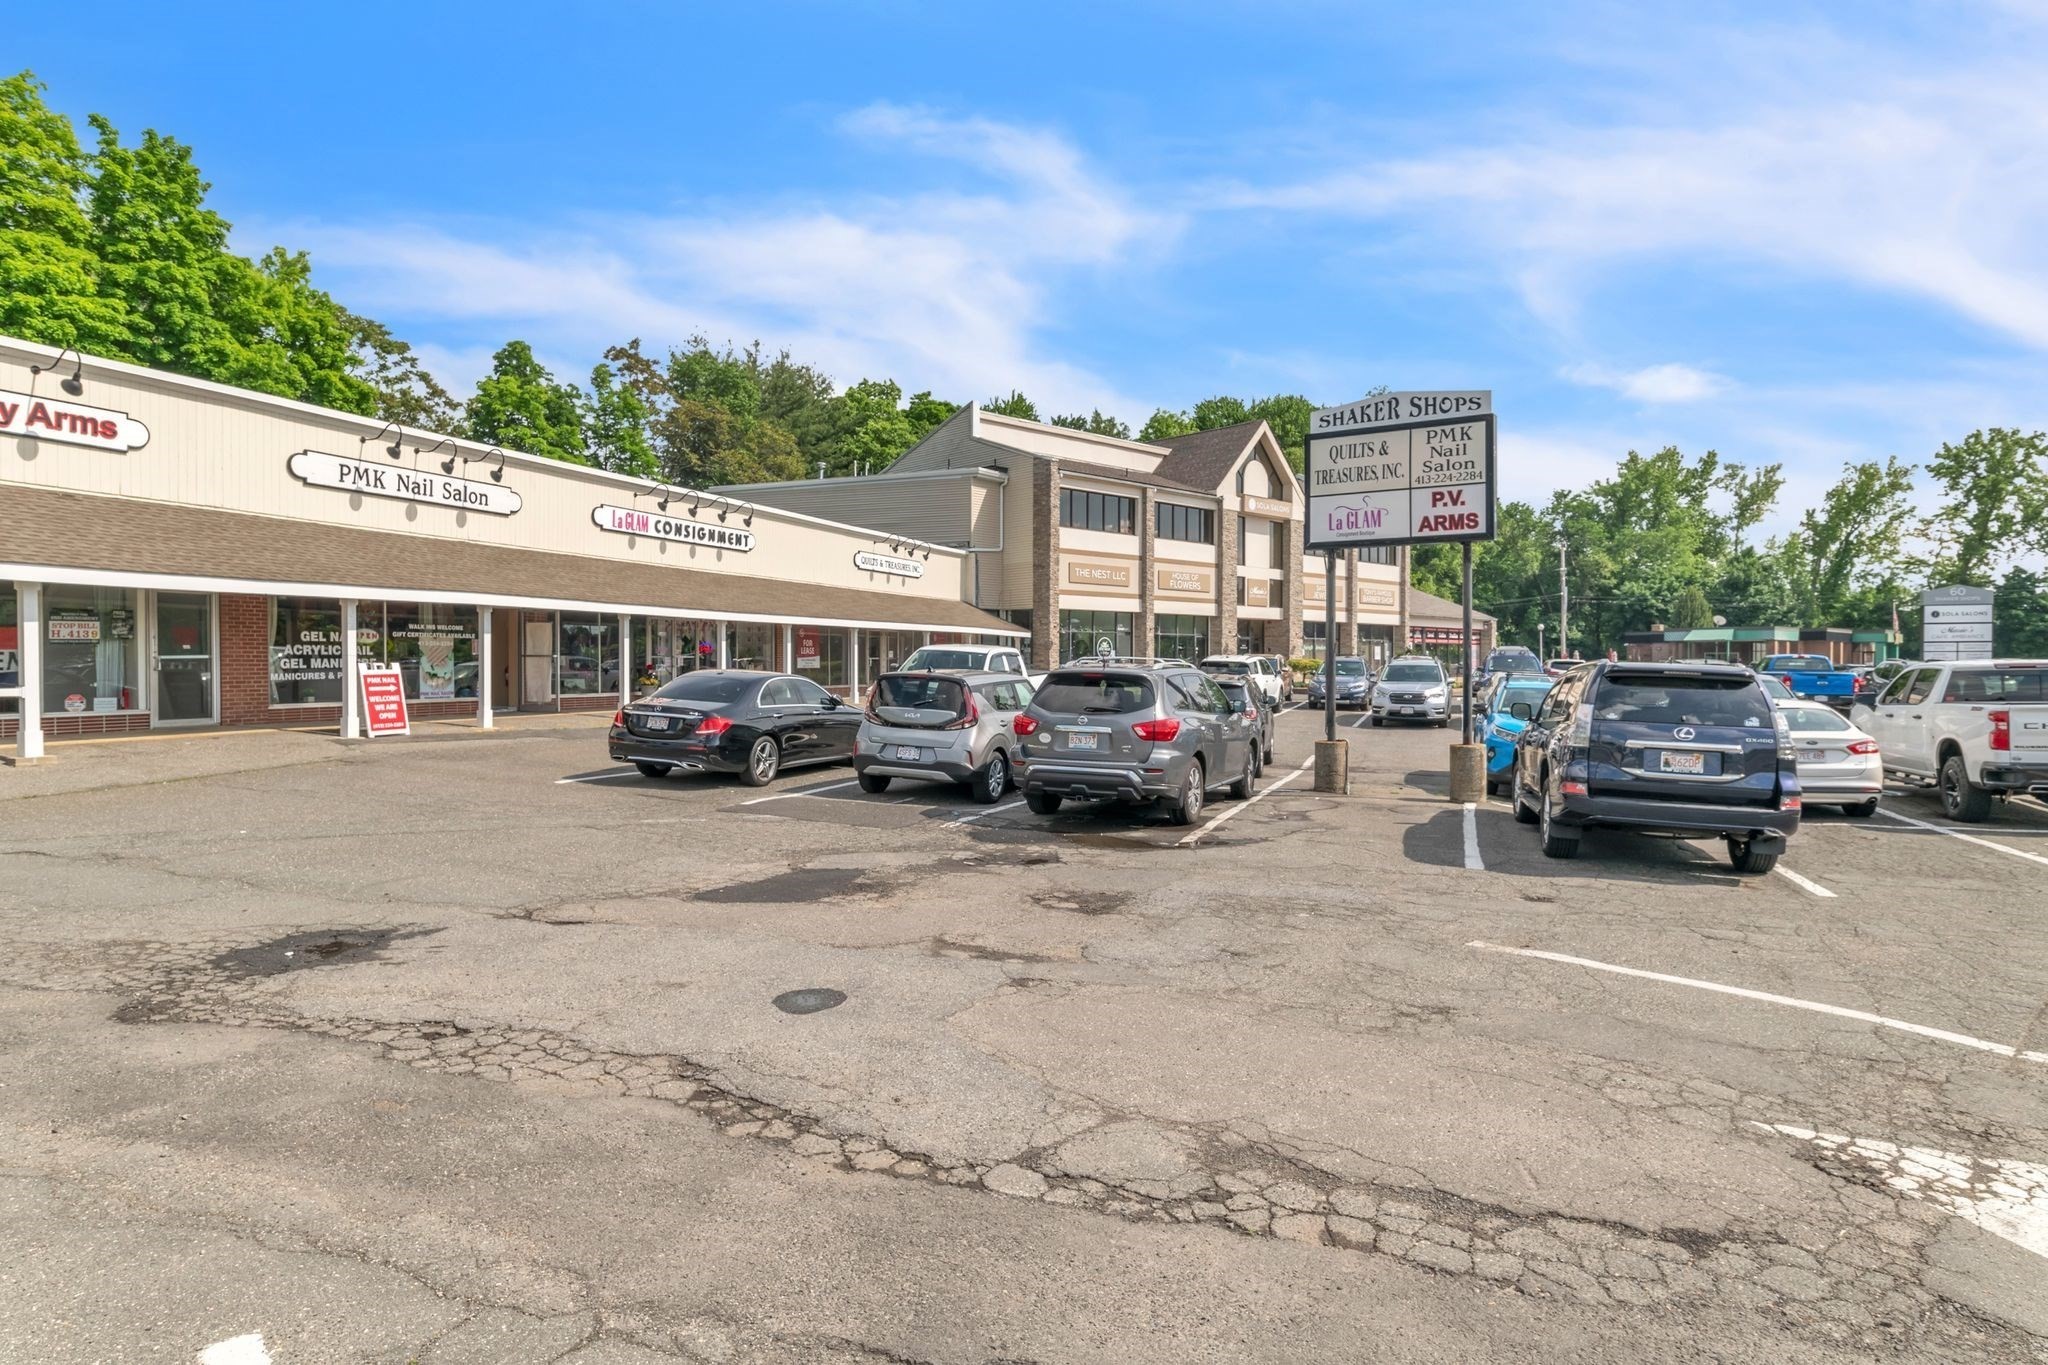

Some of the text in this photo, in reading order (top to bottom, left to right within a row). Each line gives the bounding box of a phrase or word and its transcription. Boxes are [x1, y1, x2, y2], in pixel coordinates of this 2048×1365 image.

[25, 402, 118, 439] Arms
[1319, 396, 1482, 428] SHAKER SHOPS
[1426, 426, 1472, 444] PMK
[1329, 440, 1389, 463] QUILTS &
[1430, 443, 1467, 458] Nail
[1315, 462, 1405, 486] TREASURES, INC.
[1422, 460, 1475, 473] Salon
[339, 464, 489, 507] PMK Nail Salon
[1415, 471, 1483, 485] 413-224-2284
[1431, 489, 1466, 508] P.V.
[612, 510, 750, 547] La GLAM CONSIGNMENT
[1328, 510, 1381, 531] La GLAM
[1418, 512, 1479, 533] ARMS
[1075, 568, 1126, 580] THE NEST LLC
[1170, 580, 1200, 589] FLOWERS
[301, 631, 326, 641] GEL
[284, 645, 342, 655] ACRYLIC
[281, 658, 307, 668] GEL
[271, 672, 325, 680] MANICURES
